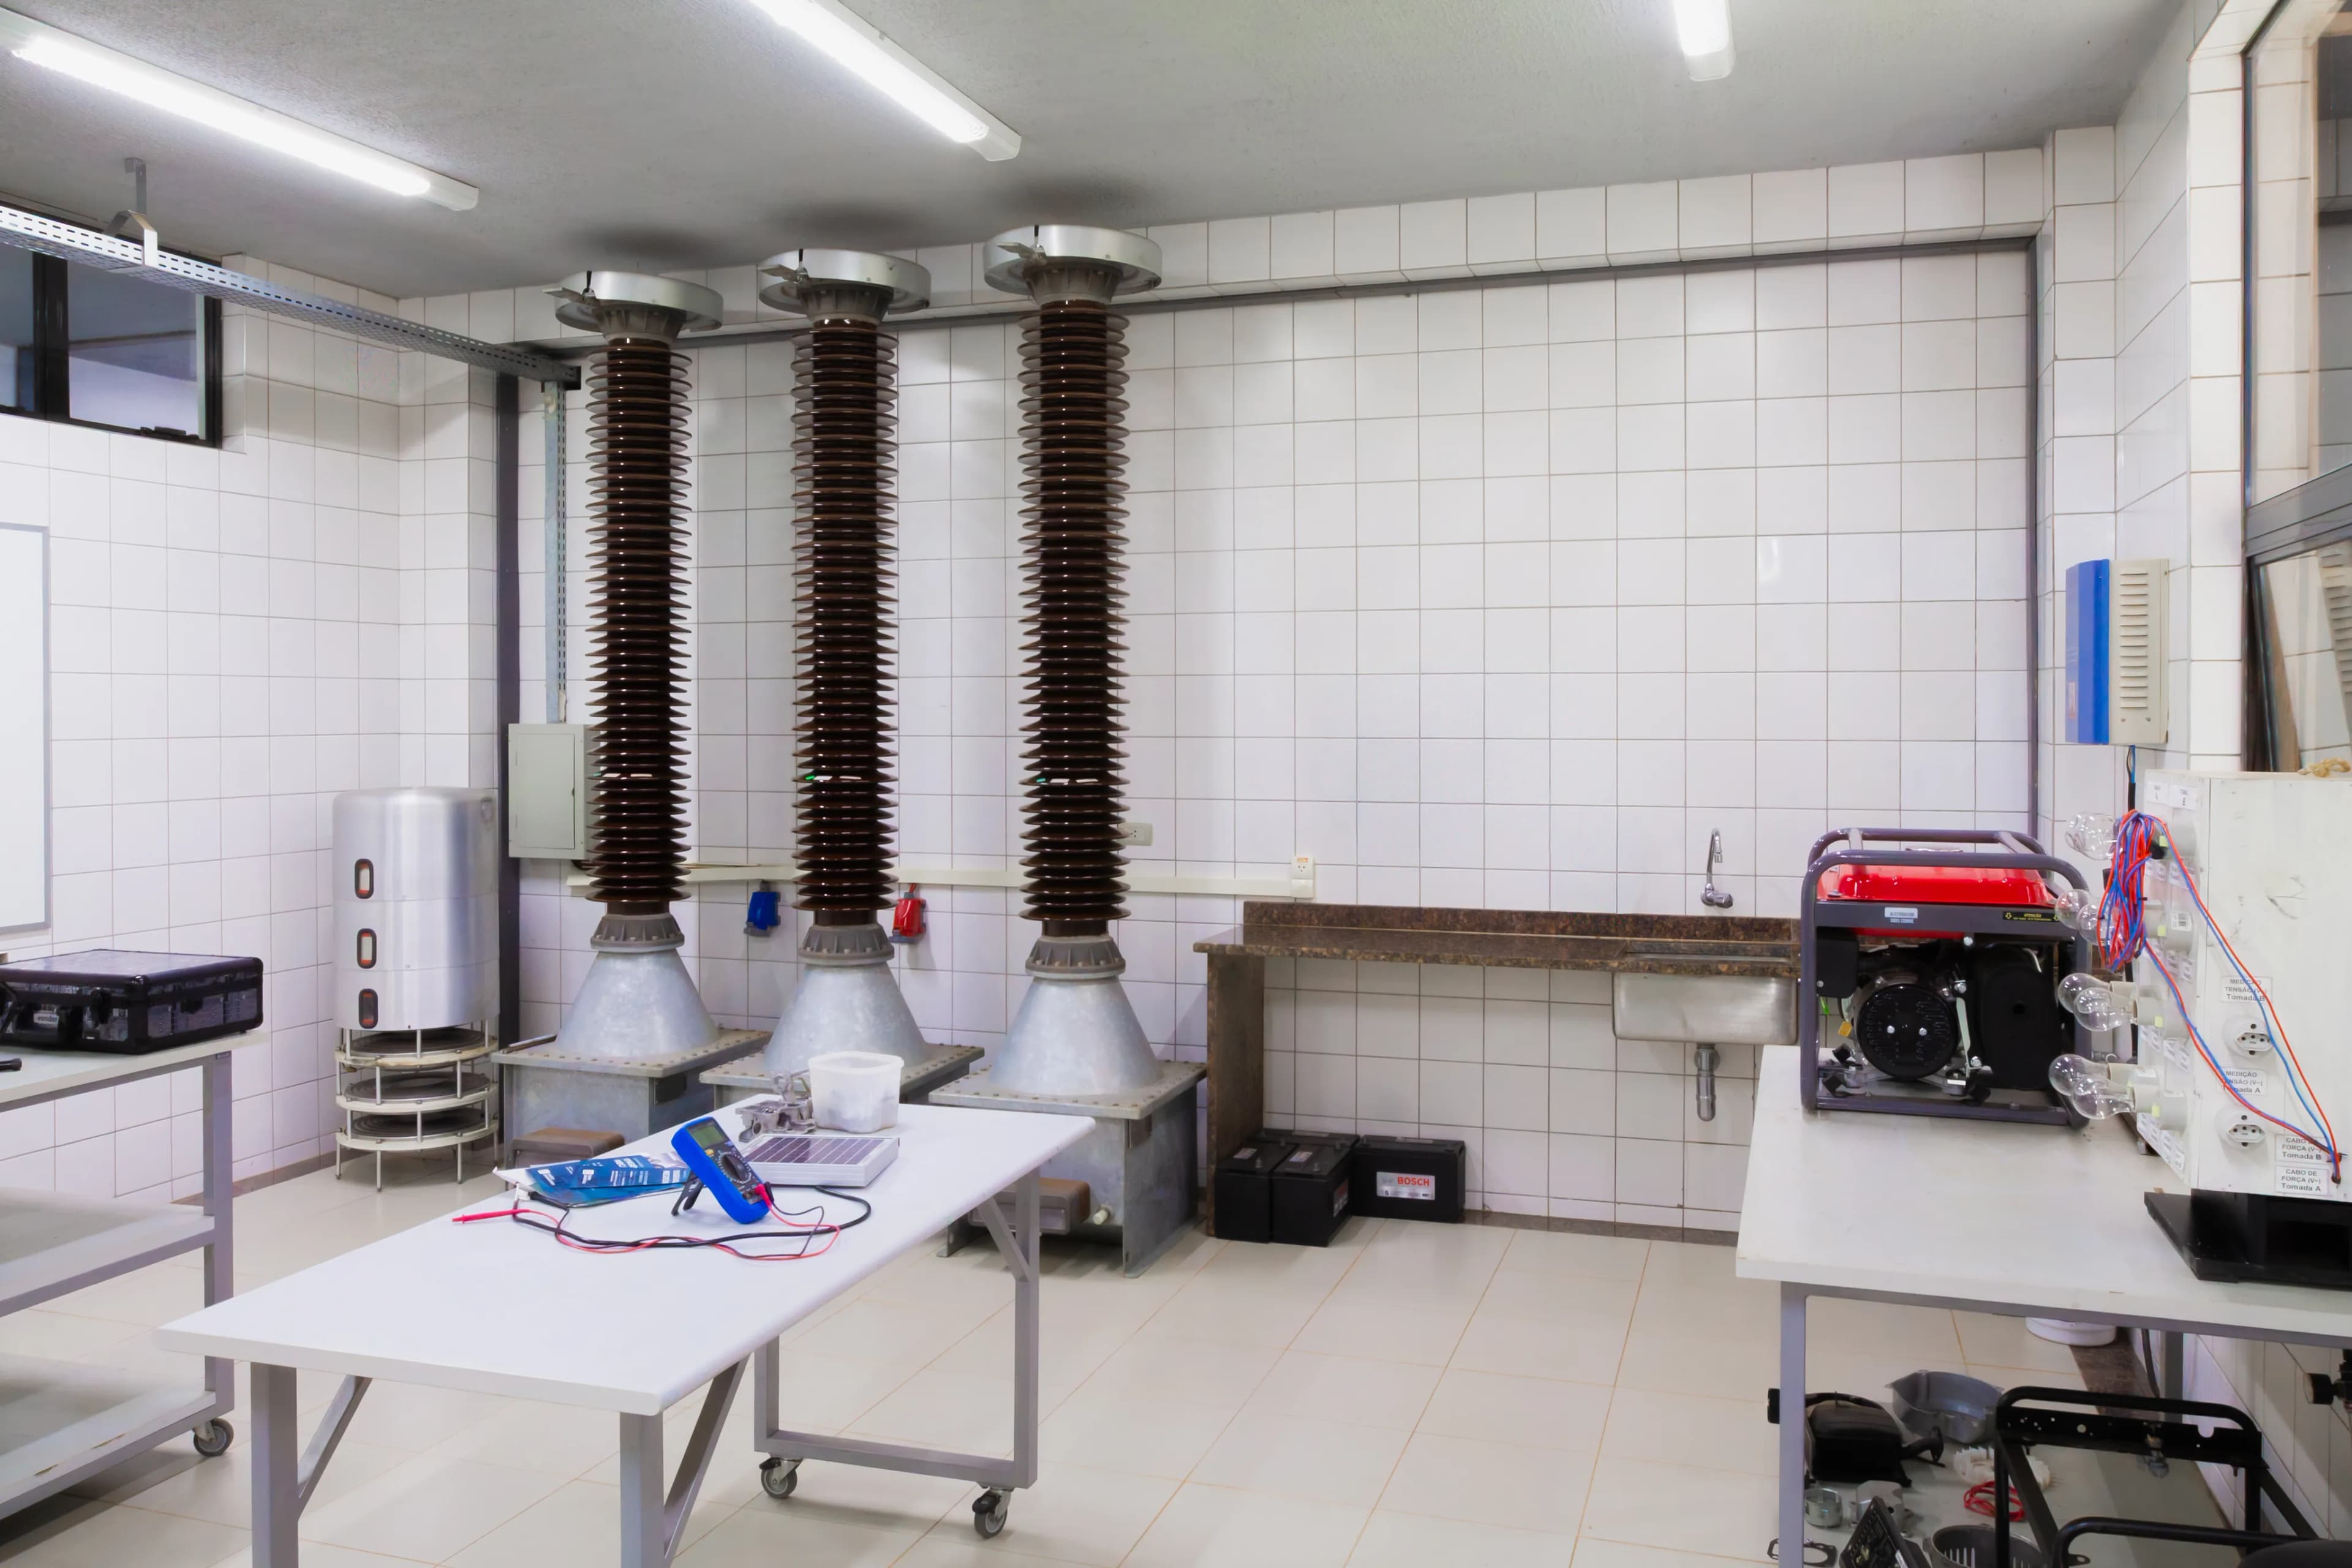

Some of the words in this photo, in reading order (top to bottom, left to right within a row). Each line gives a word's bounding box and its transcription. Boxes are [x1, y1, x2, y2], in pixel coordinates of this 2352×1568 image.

[2282, 1144, 2307, 1152] FORÇA
[2282, 1151, 2313, 1160] Tomada
[1397, 1176, 1430, 1186] BOSCH
[2281, 1183, 2313, 1191] Tomada
